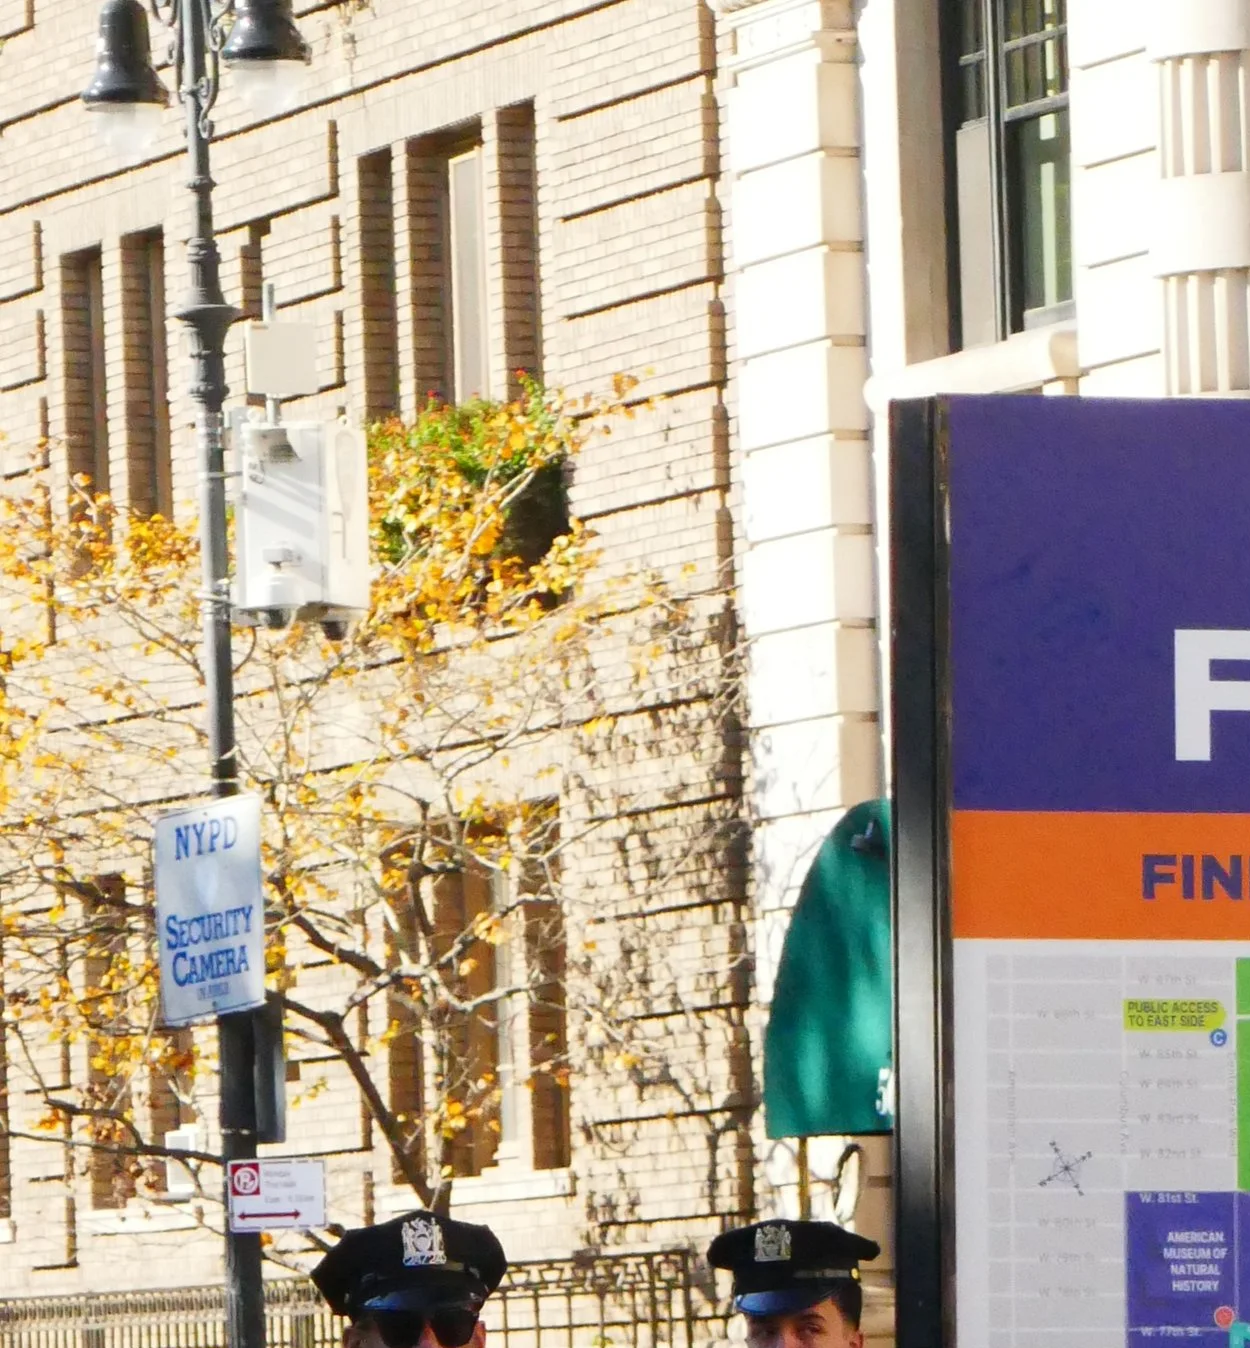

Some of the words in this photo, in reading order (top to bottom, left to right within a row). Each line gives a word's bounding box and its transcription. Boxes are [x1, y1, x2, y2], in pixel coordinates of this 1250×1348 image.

[175, 816, 238, 860] NYPD
[166, 906, 252, 950] SECURITY
[173, 945, 249, 987] CAMERA
[1128, 1002, 1169, 1013] PUBLIC
[1172, 1002, 1218, 1013] ACCESS
[1128, 1016, 1144, 1026] TO
[1147, 1016, 1176, 1026] EAST
[1180, 1016, 1205, 1026] SIDE
[1167, 1232, 1224, 1242] AMERICAN
[1164, 1248, 1210, 1259] MUSEUM
[1212, 1248, 1227, 1259] OF
[1171, 1264, 1220, 1275] NATURAL
[1172, 1281, 1219, 1291] HISTORY
